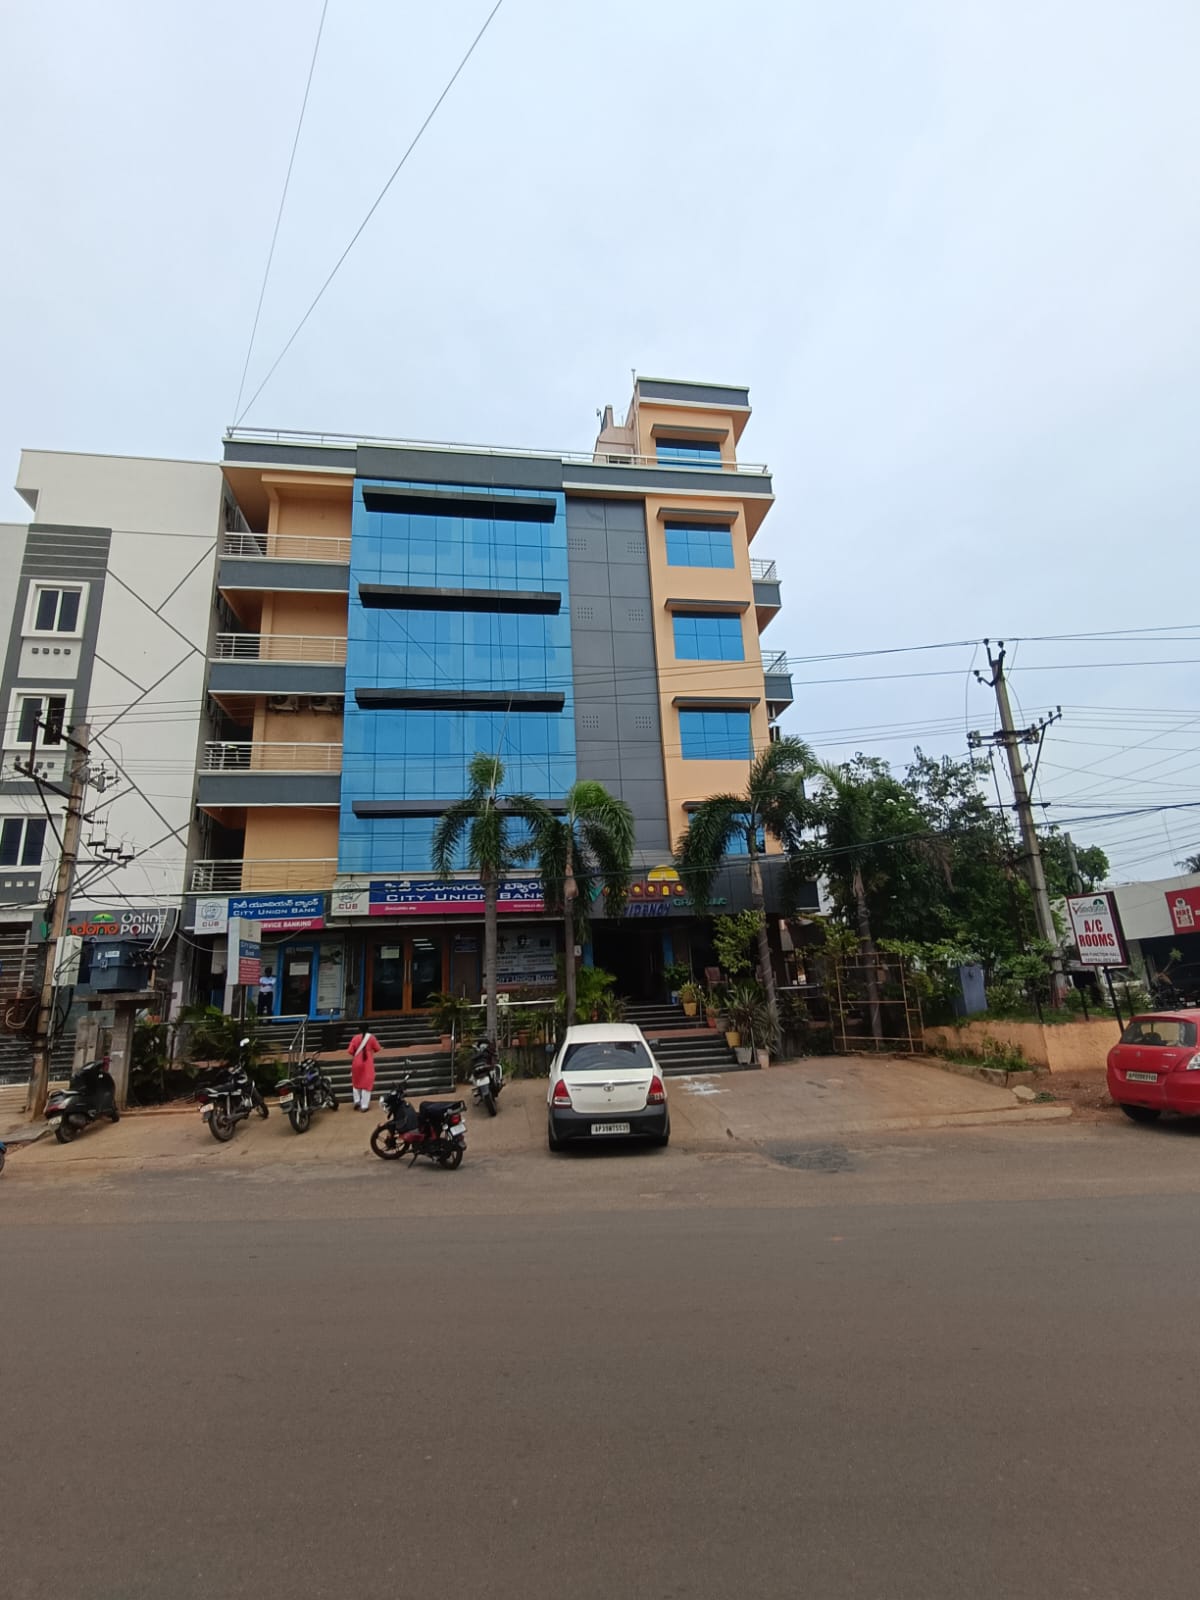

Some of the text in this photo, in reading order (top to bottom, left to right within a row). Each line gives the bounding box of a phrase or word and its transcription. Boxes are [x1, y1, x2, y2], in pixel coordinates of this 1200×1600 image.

[386, 893, 426, 902] CITY
[500, 891, 544, 900] BANK
[338, 902, 358, 910] CUB
[283, 920, 312, 928] BANKING
[1084, 919, 1104, 933] A/C
[1078, 934, 1116, 948] ROOMS
